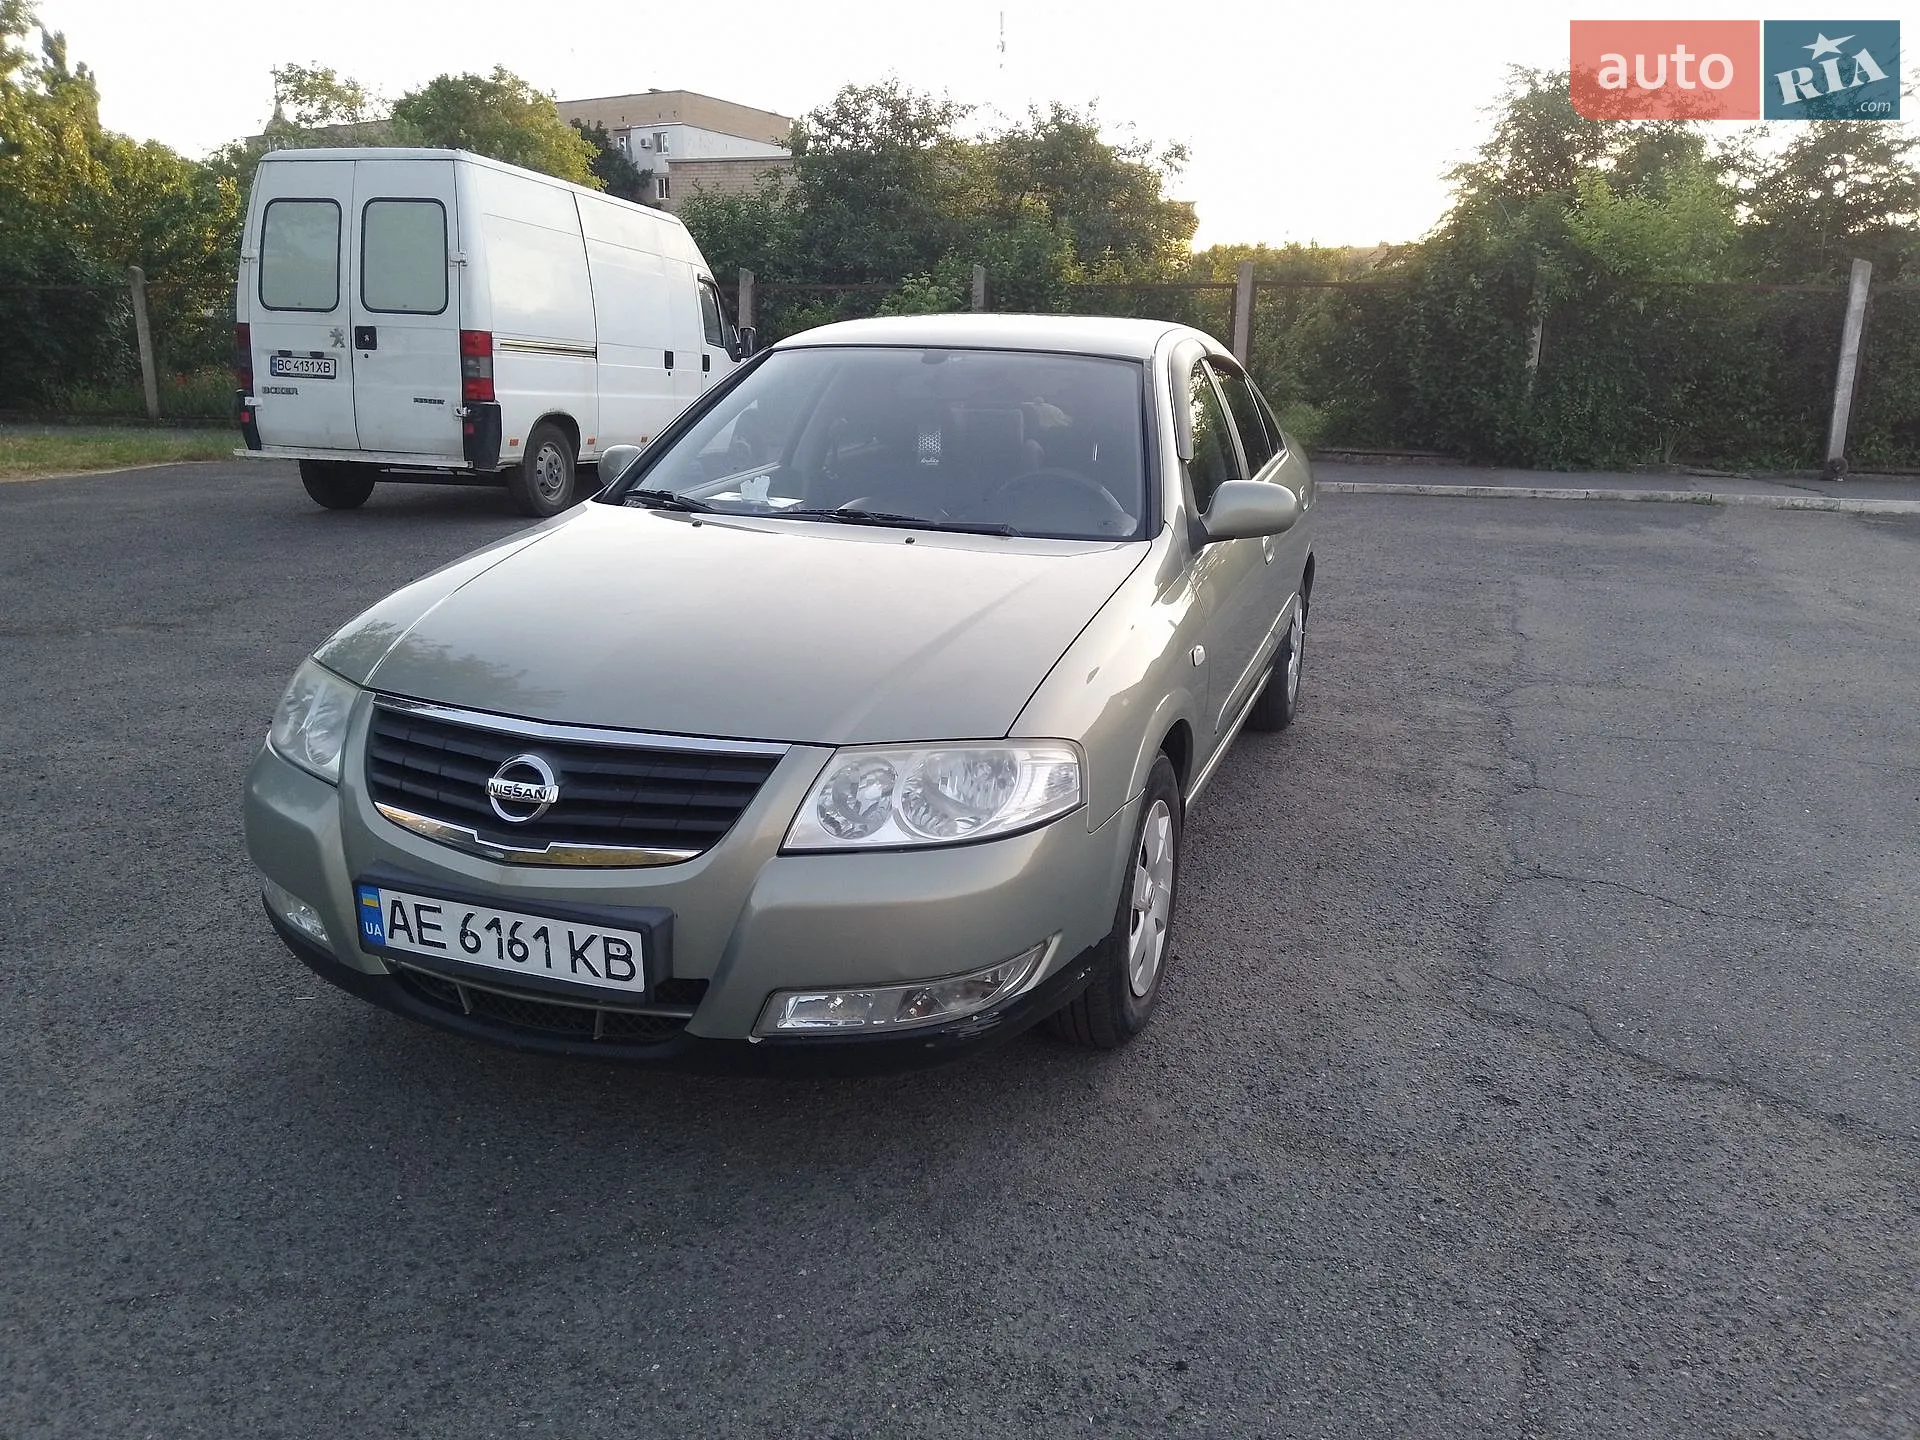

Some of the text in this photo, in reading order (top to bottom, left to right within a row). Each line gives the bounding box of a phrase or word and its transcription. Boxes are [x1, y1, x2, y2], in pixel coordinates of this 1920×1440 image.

[277, 359, 292, 371] BC
[489, 783, 547, 800] NISSAN
[365, 921, 383, 937] UA
[388, 899, 637, 982] AE 6161 KB
